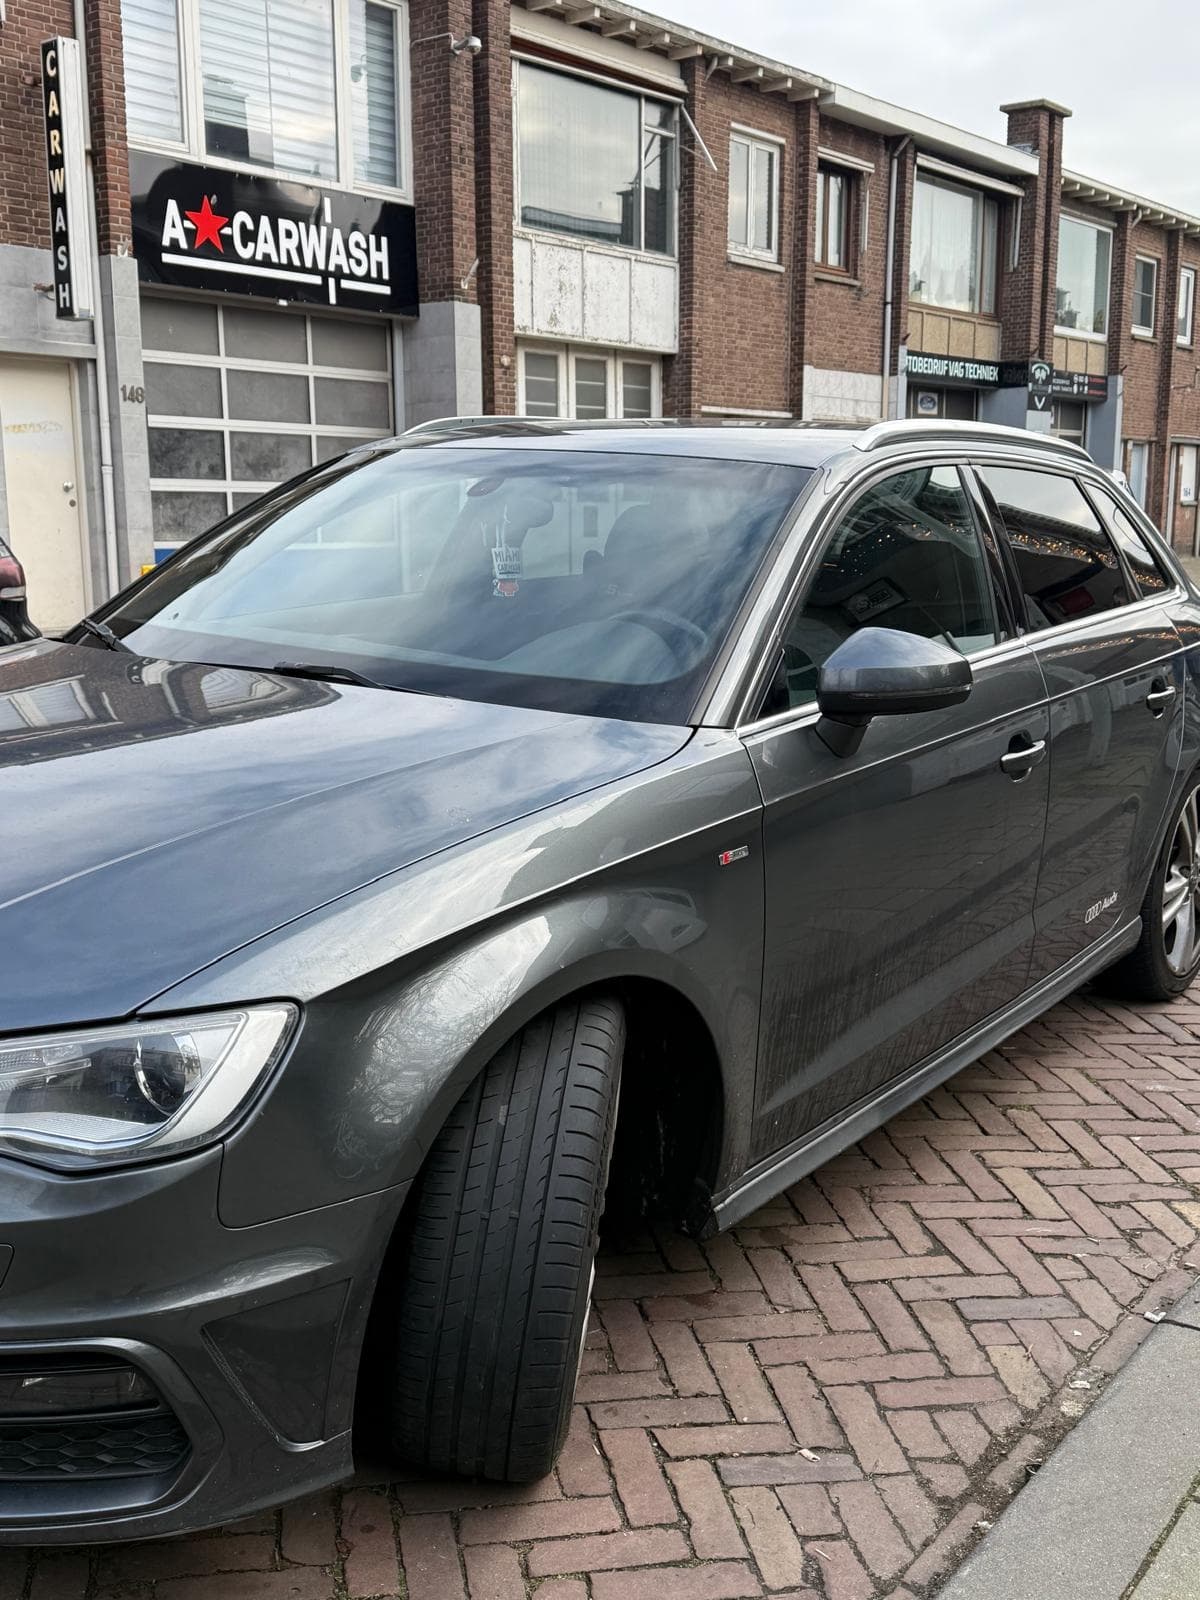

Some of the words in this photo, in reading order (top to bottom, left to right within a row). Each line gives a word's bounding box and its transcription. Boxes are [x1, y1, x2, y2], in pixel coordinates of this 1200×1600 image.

[46, 50, 70, 308] CARWASH
[949, 361, 964, 378] VAG
[965, 363, 999, 381] TECHNIEK
[120, 384, 145, 404] 148
[1101, 891, 1118, 911] Audi
